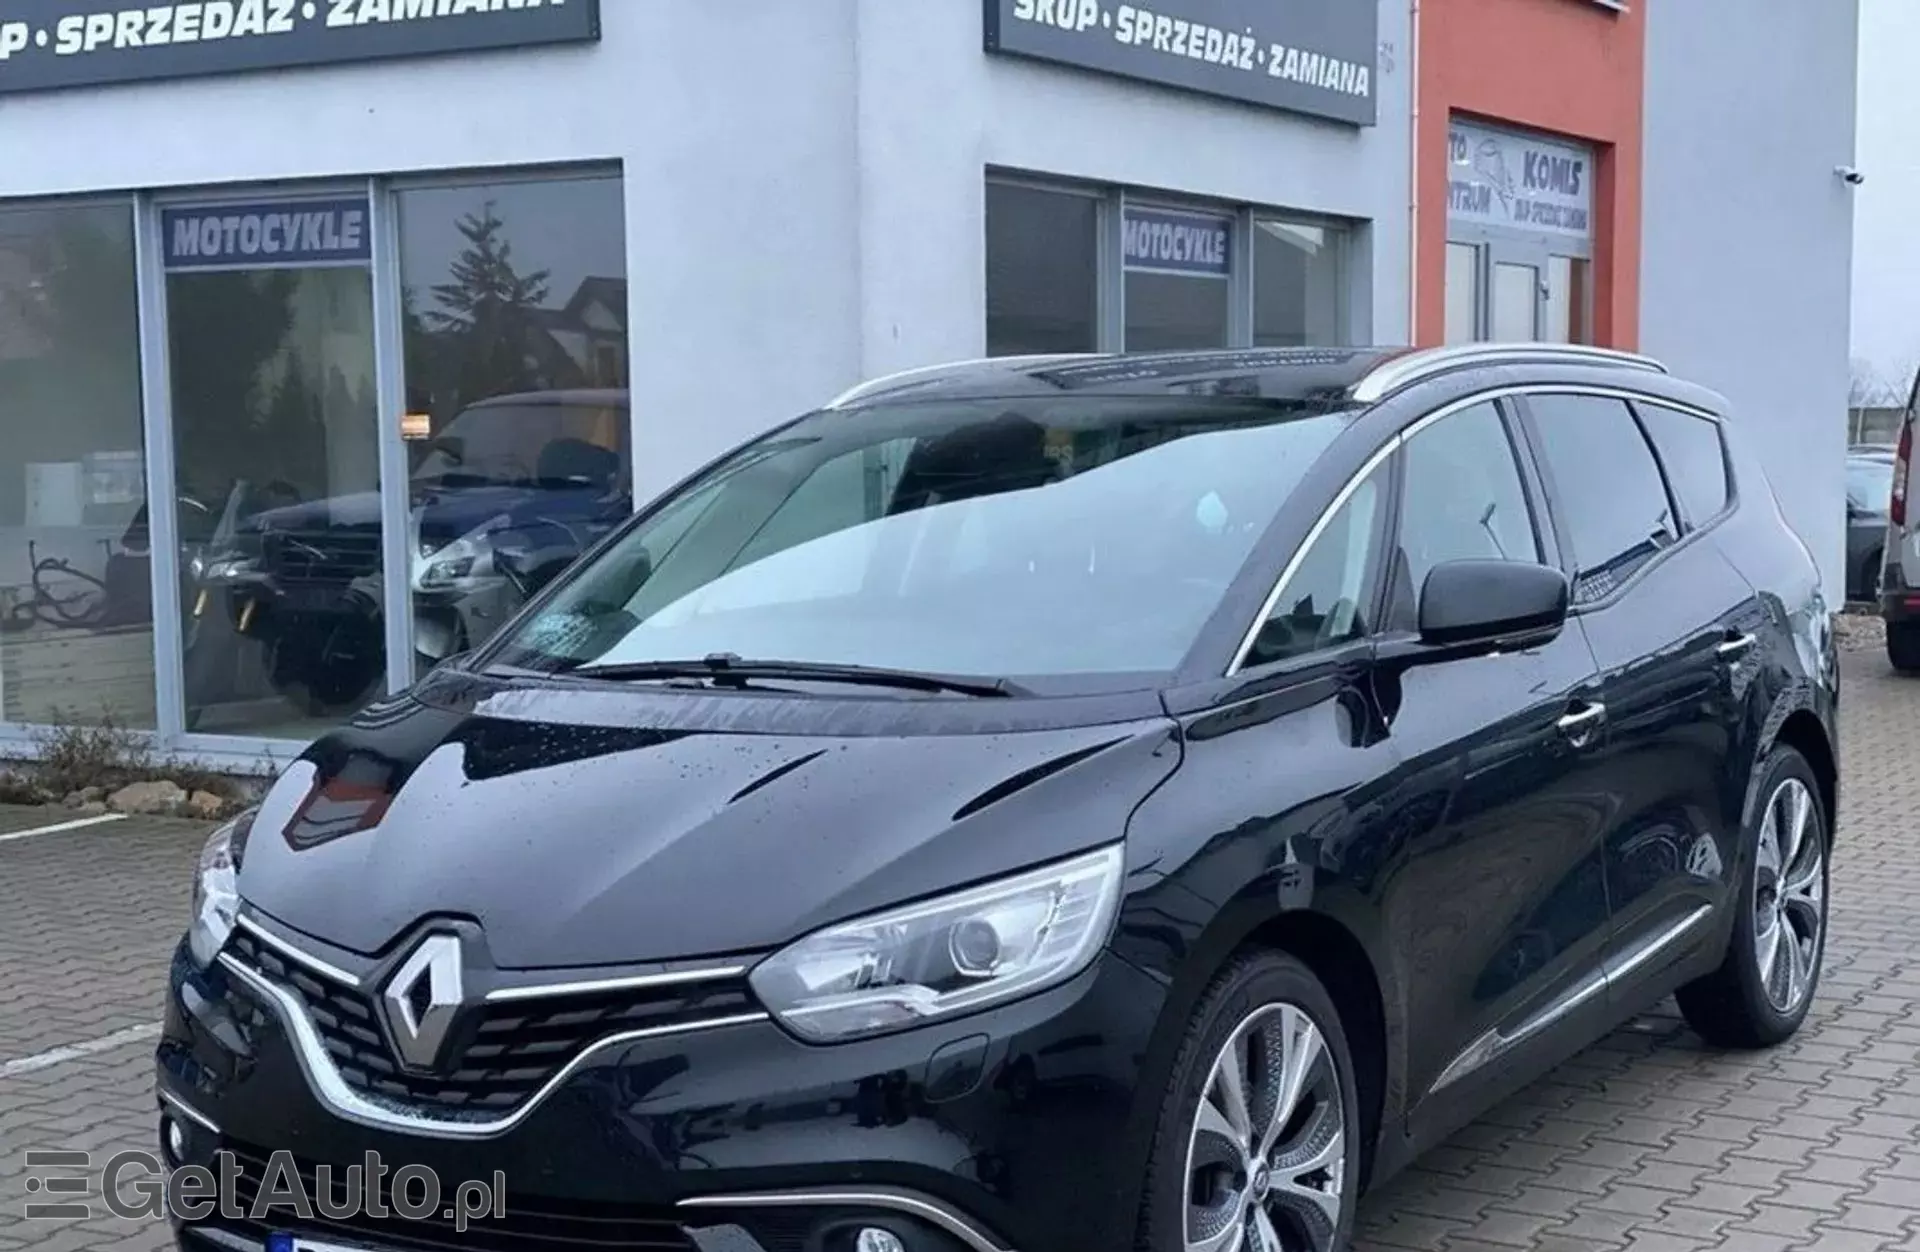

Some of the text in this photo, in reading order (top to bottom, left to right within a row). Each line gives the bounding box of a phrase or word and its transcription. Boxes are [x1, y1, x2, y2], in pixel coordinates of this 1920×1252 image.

[1115, 5, 1256, 70] SPRZEDAŻ
[1268, 43, 1369, 97] ZAMIANA
[1523, 151, 1583, 196] KOMIS
[172, 210, 364, 257] MOTOCYKLE
[1122, 219, 1225, 264] MOTOCYKLE
